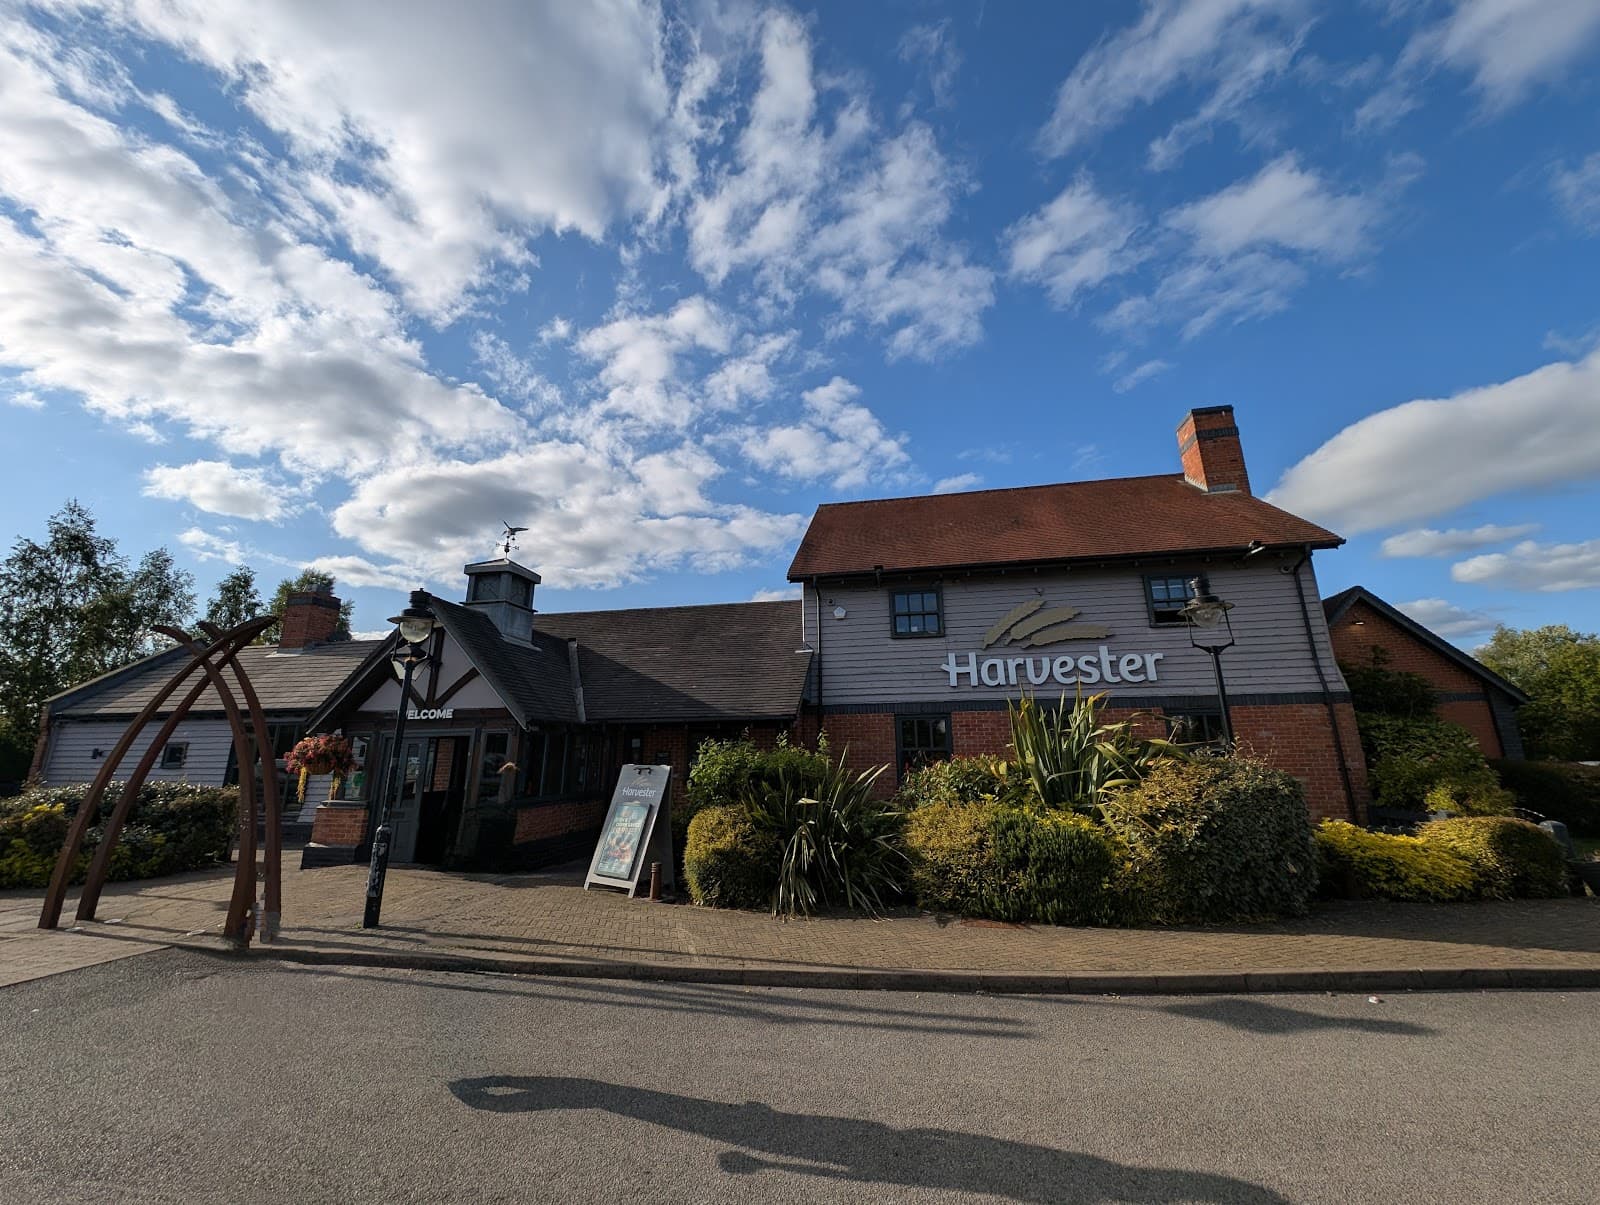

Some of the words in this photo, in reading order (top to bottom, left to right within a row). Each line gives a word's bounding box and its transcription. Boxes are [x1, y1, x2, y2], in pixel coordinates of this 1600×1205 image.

[941, 645, 1164, 687] Harvester
[406, 709, 453, 720] ELCOME
[622, 786, 656, 798] Harvester
